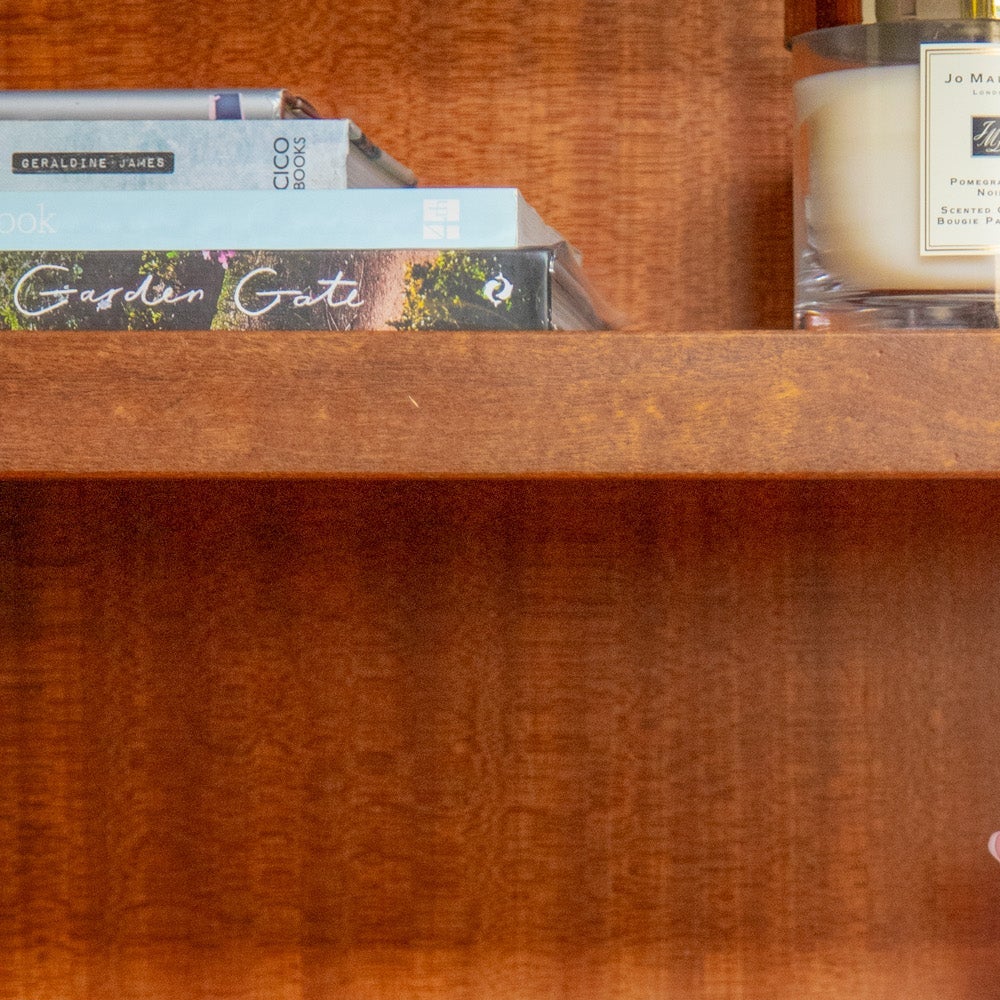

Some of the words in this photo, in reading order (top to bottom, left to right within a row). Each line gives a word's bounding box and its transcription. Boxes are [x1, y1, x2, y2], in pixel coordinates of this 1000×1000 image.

[21, 157, 108, 169] GERALDINE
[119, 157, 166, 169] JAMES
[273, 137, 290, 190] CICO
[293, 136, 306, 190] BOOKS
[937, 217, 979, 225] BOUGIE
[941, 206, 991, 215] SCENTED
[14, 264, 204, 316] Garden
[234, 267, 364, 317] Gate
